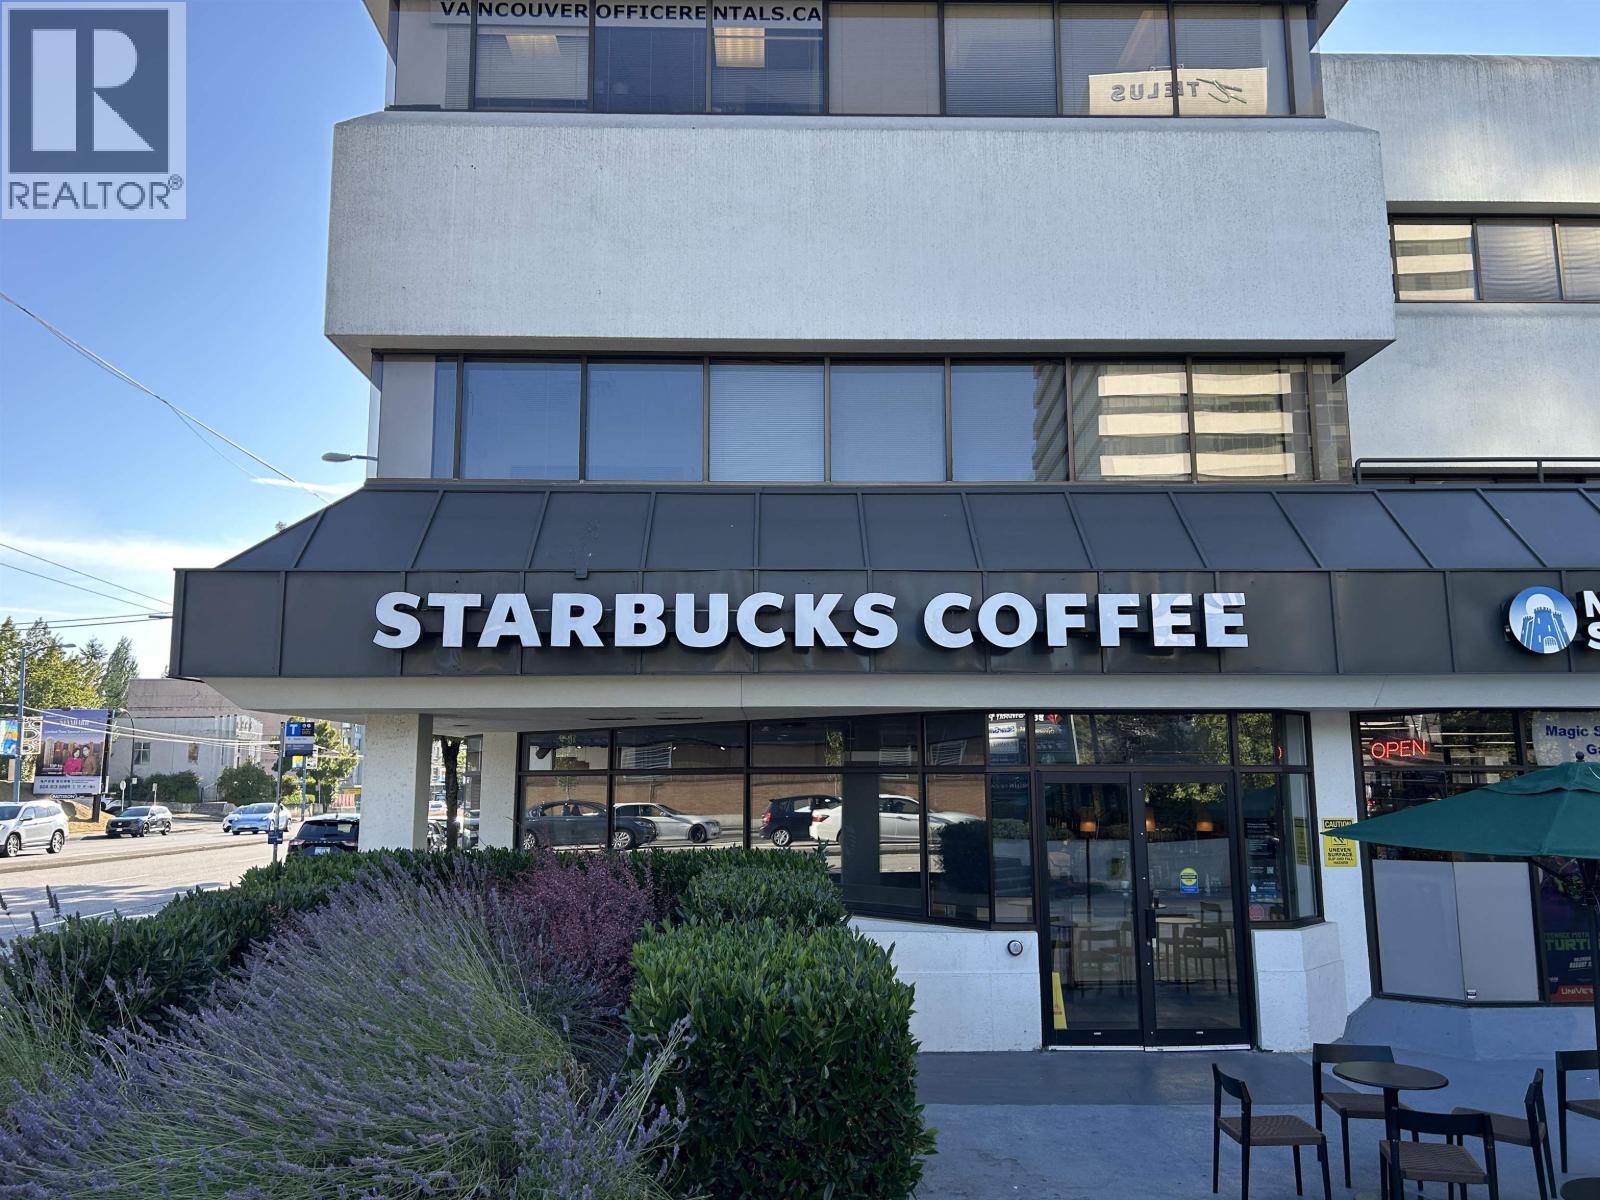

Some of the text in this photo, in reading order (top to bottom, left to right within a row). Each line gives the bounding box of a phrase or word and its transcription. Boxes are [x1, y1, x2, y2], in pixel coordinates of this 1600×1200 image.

[372, 591, 1249, 649] STARBUCKS COFFEE
[1545, 724, 1589, 739] Magic
[1371, 740, 1426, 759] OPEN
[1586, 743, 1600, 755] G
